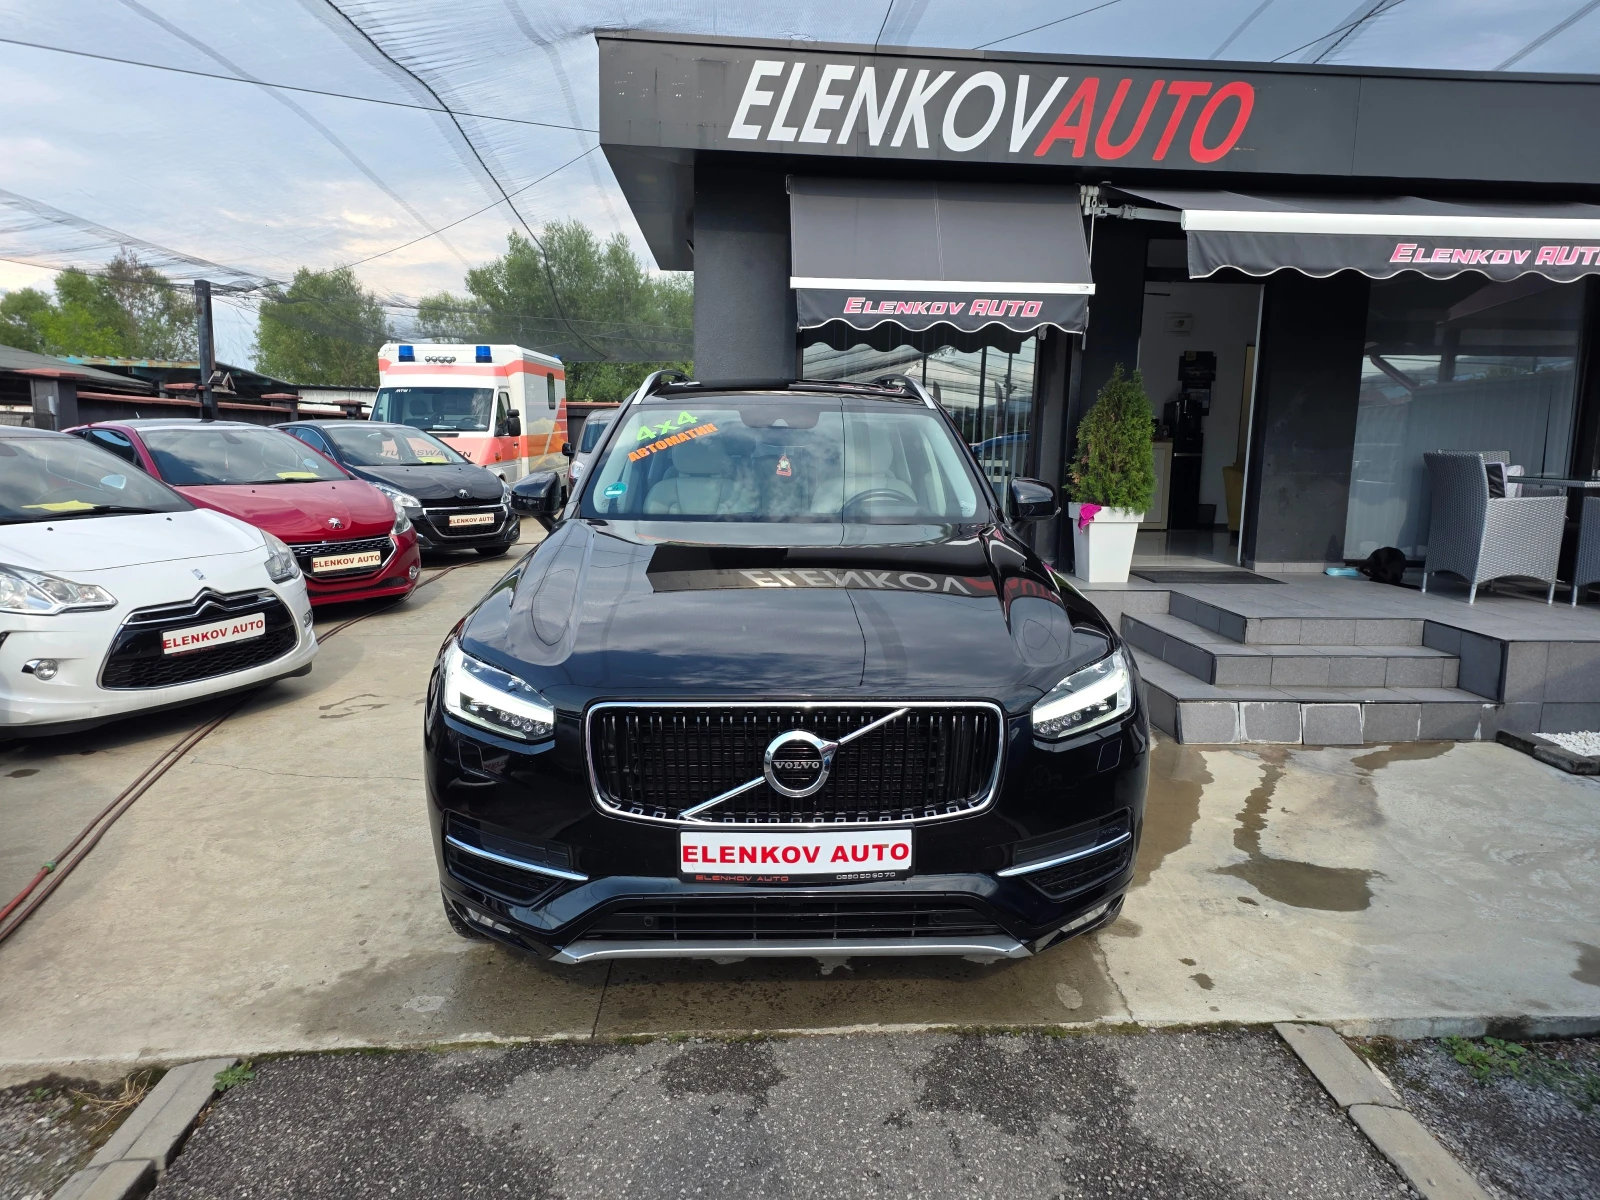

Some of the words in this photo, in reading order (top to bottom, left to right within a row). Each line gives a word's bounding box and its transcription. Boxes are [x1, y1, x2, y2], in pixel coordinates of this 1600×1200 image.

[1389, 243, 1531, 265] ELENKOV
[1535, 246, 1600, 266] AUT
[843, 297, 966, 315] ELENKOV
[968, 299, 1044, 317] AUTO
[312, 557, 355, 568] ELENKOV
[357, 554, 380, 563] AUTO
[163, 628, 228, 649] ELENKOV
[231, 619, 264, 635] AUTO
[773, 761, 820, 769] VOLVO
[682, 845, 821, 864] ELENKOV
[830, 842, 910, 863] AUTO
